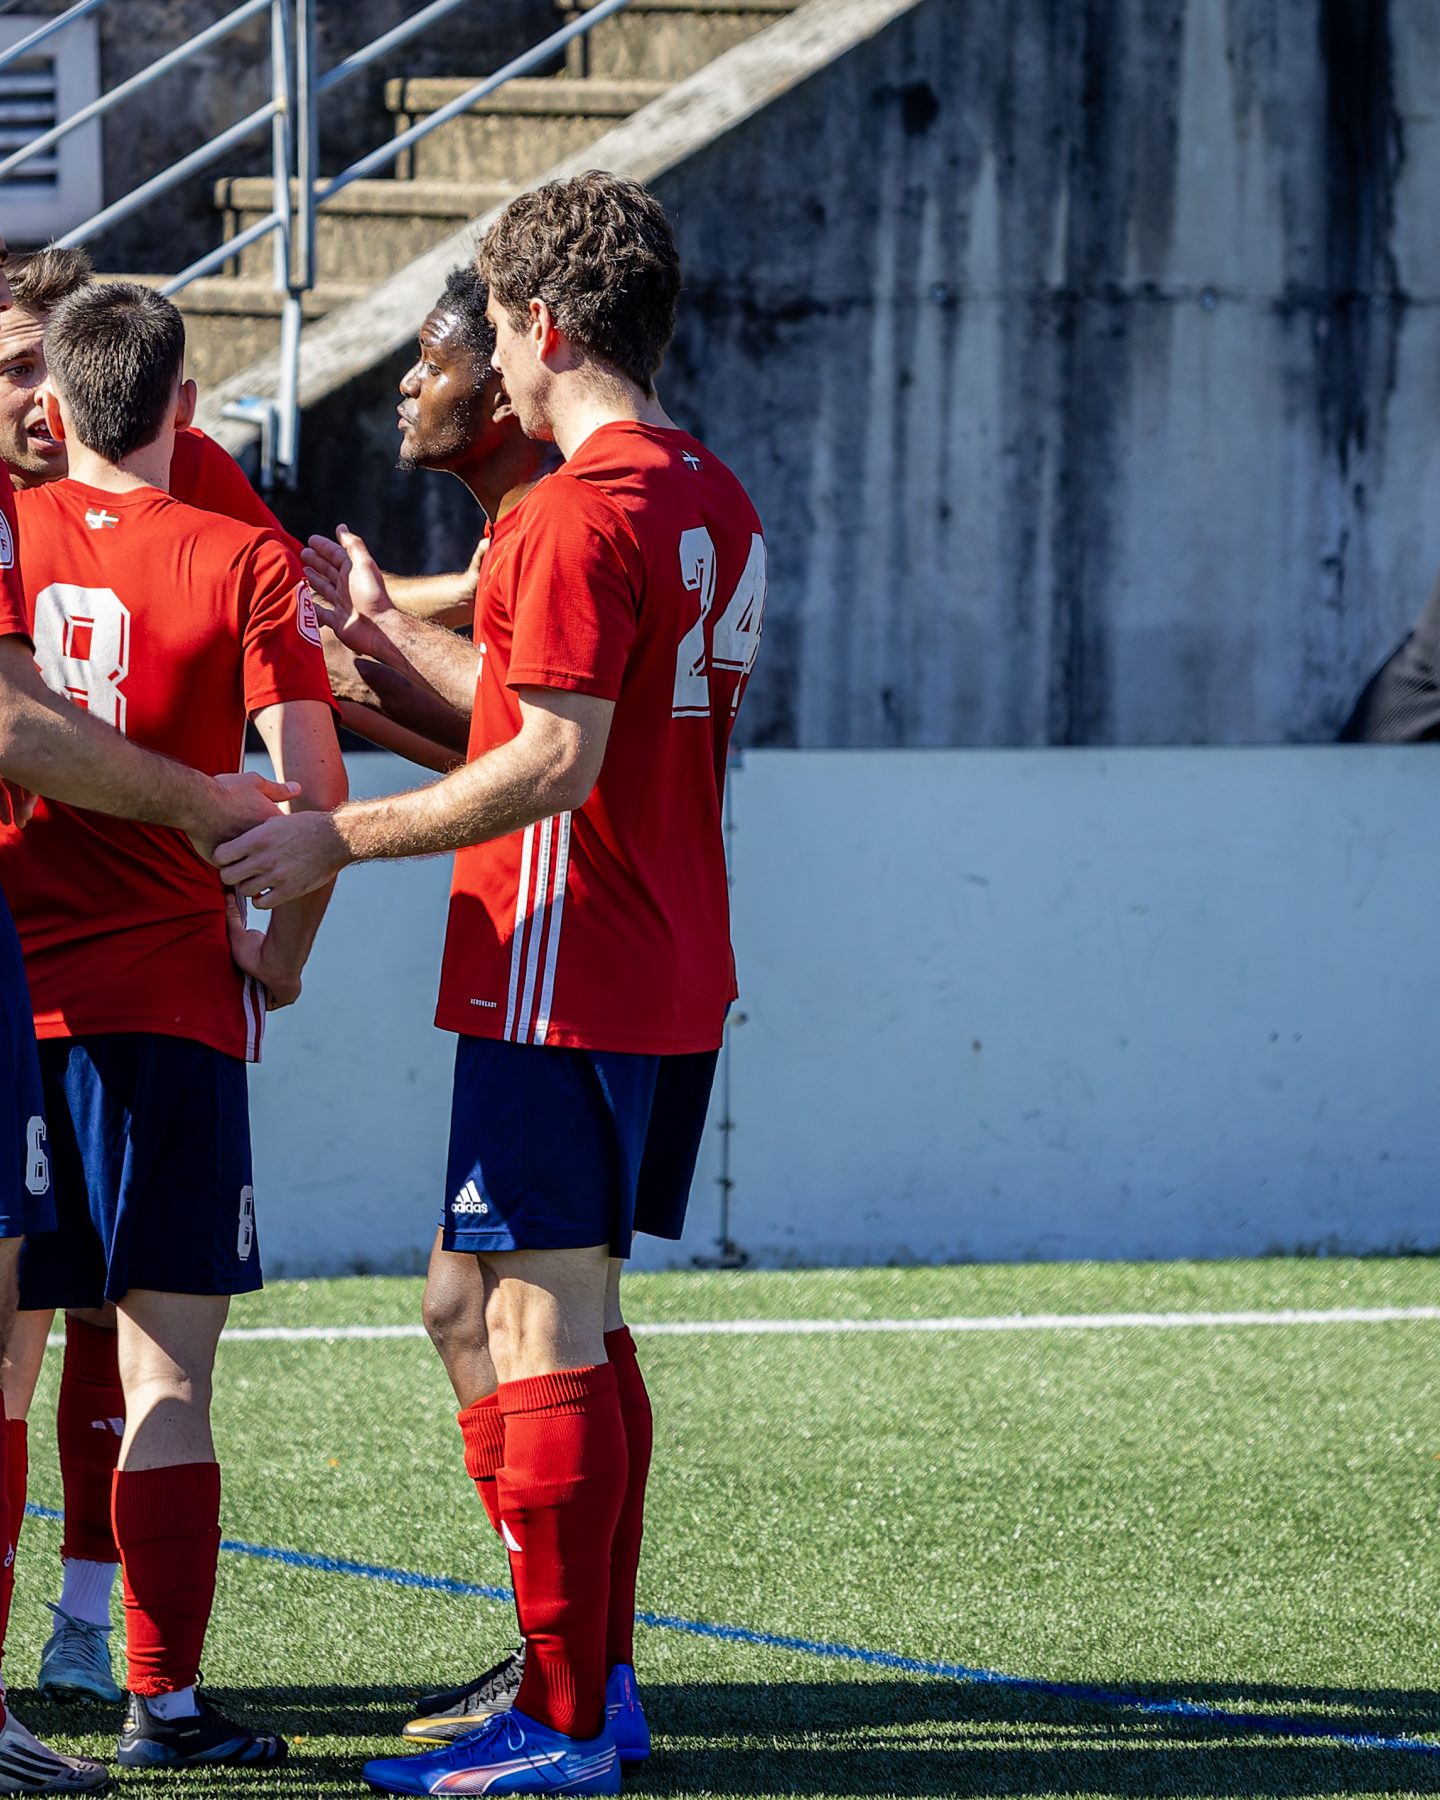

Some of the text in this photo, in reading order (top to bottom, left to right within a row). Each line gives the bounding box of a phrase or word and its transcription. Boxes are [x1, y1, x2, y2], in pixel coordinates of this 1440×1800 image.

[33, 582, 131, 738] 8
[671, 526, 767, 718] 24
[25, 1115, 50, 1195] 6
[237, 1185, 254, 1261] 8
[451, 1200, 488, 1214] adidas
